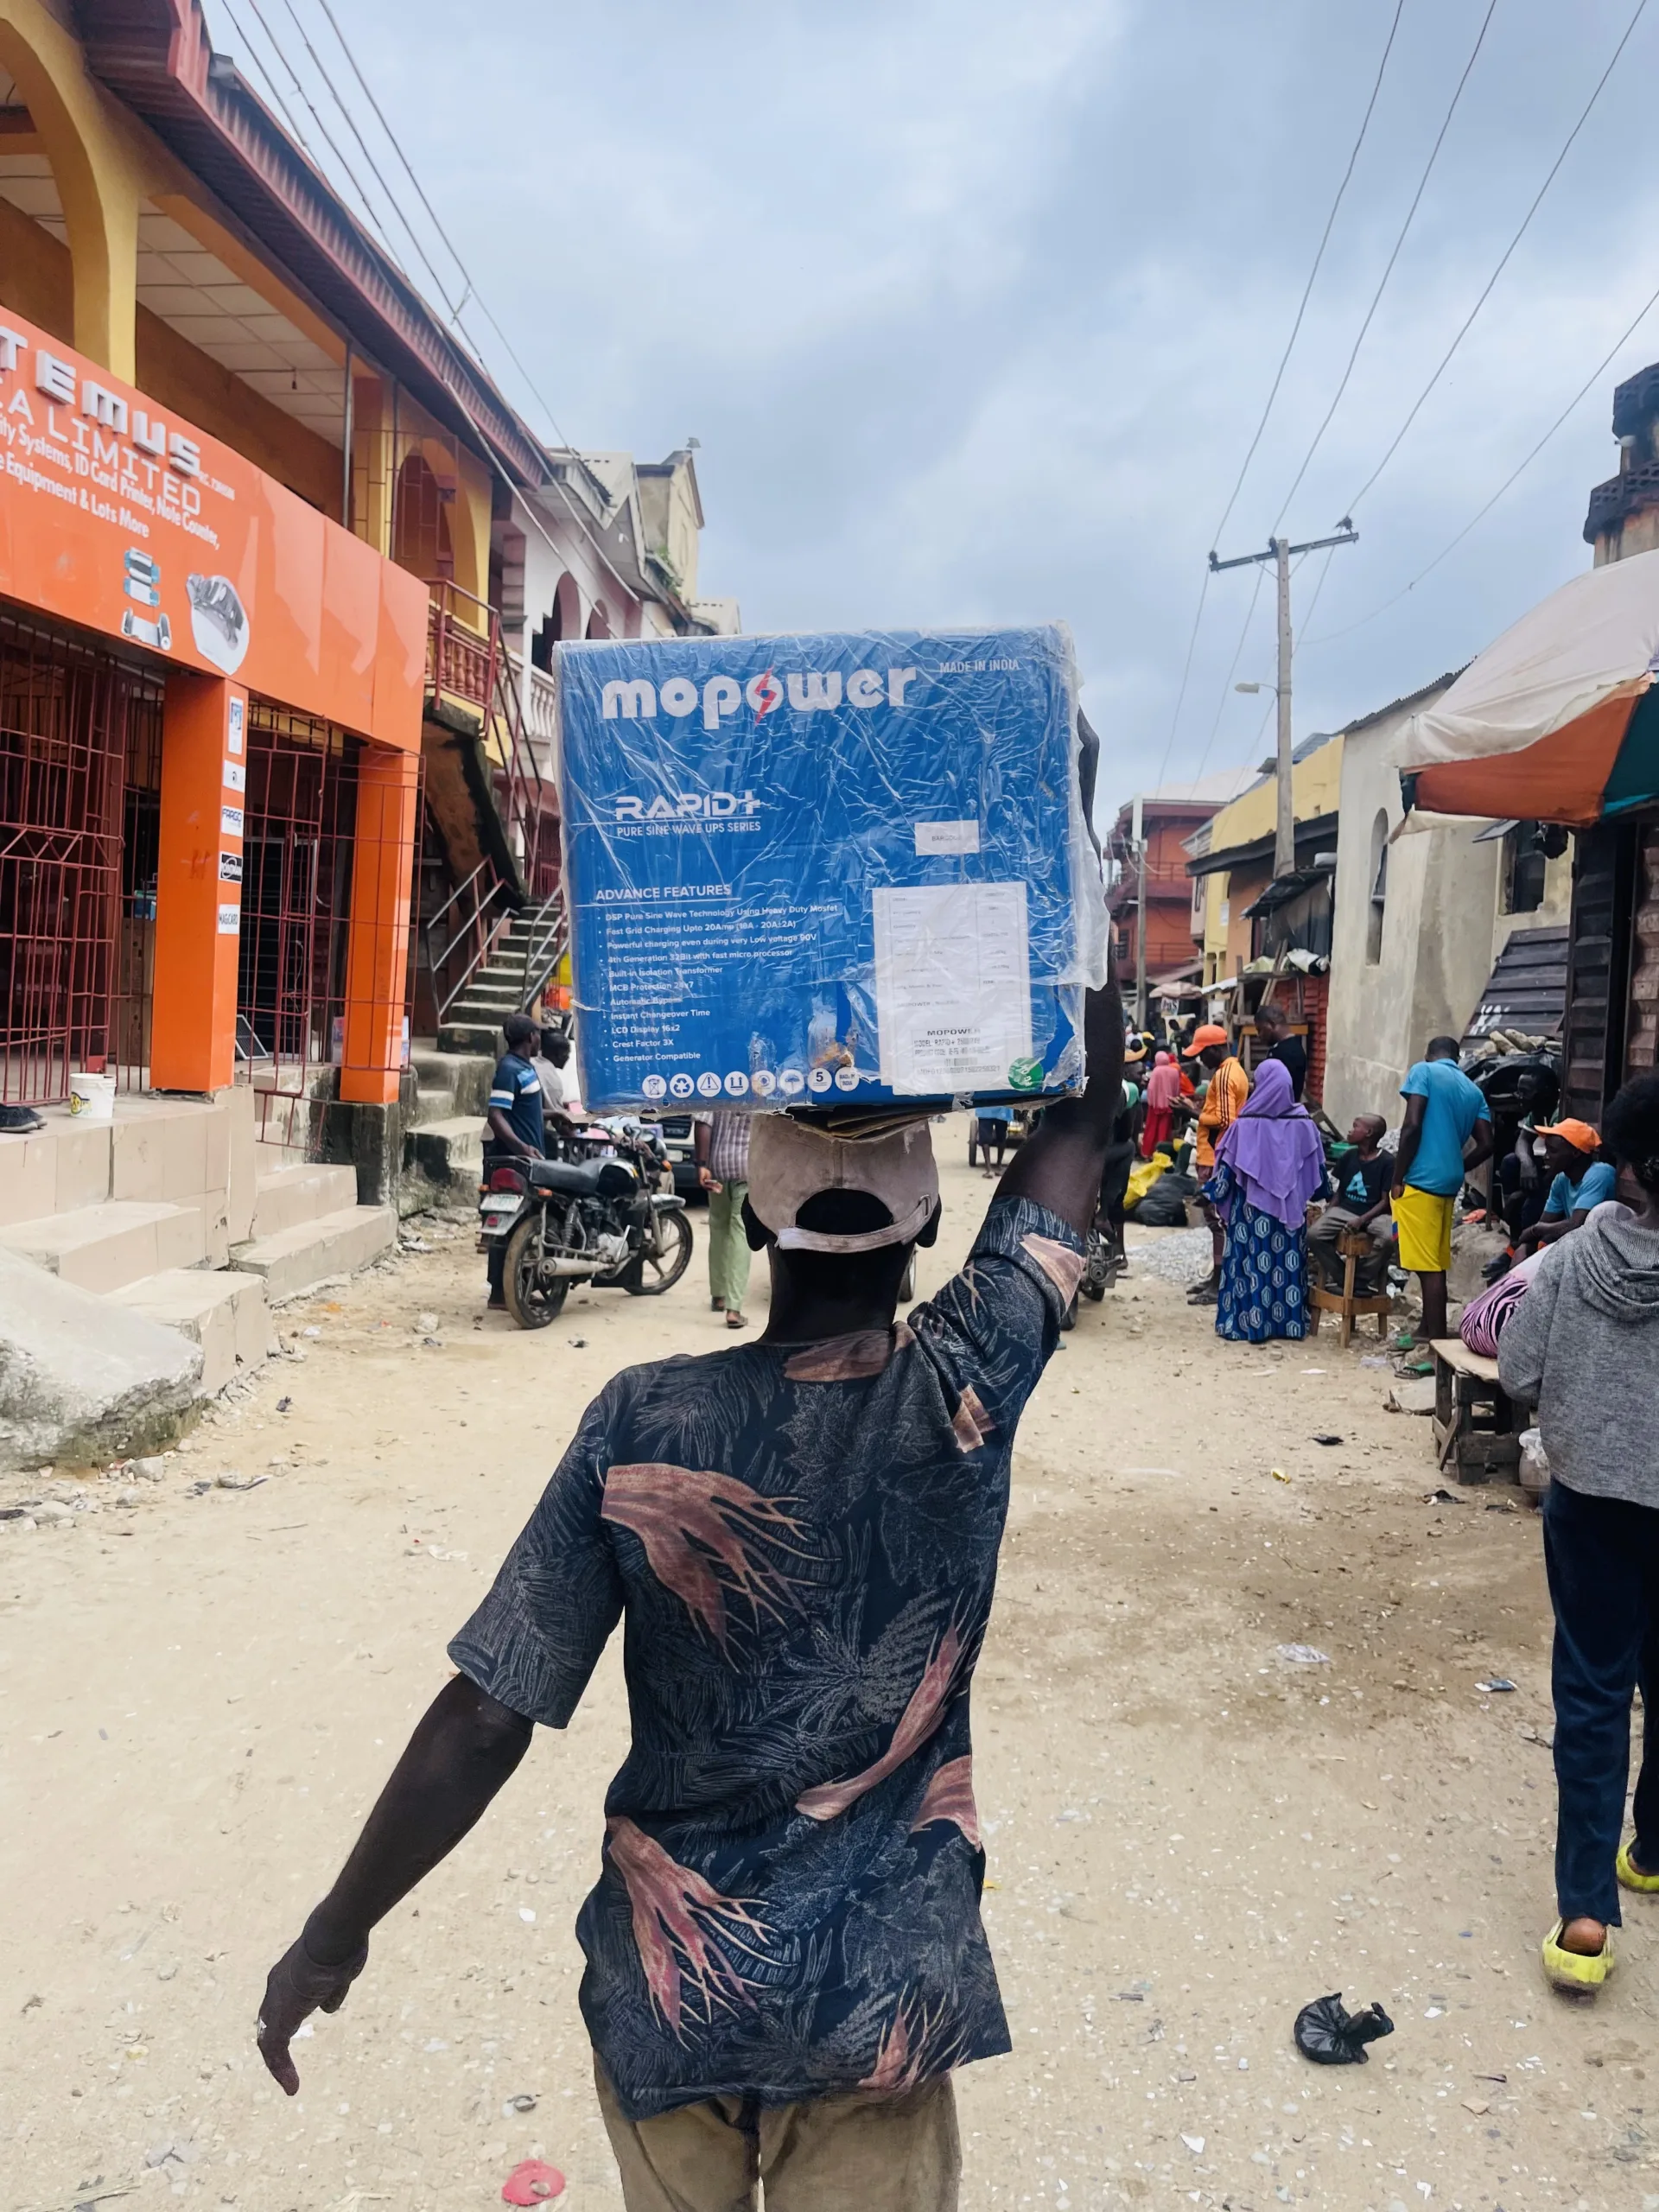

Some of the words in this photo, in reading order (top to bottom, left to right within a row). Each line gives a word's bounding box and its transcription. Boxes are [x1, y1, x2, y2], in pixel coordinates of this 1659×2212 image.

[18, 423, 73, 474] Systems,
[74, 453, 89, 476] ID
[90, 461, 118, 493] Card
[48, 405, 200, 516] LIMITED
[6, 451, 77, 505] Equipment
[79, 488, 90, 511] &
[91, 493, 118, 524] Lots
[119, 506, 149, 538] More
[940, 661, 972, 673] MADE
[975, 660, 985, 671] IN
[989, 658, 1020, 671] INDIA
[603, 665, 917, 729] mopower
[617, 826, 643, 837] PURE
[645, 825, 669, 836] SINE
[672, 823, 702, 835] WAVE
[705, 823, 725, 833] UPS
[727, 822, 761, 832] SERIES
[596, 887, 660, 900] ADVANCE
[664, 885, 732, 898] FEATURES
[689, 910, 734, 919] Technology
[645, 925, 681, 935] Charging
[683, 925, 702, 933] Upto
[645, 940, 679, 949] charging
[623, 954, 667, 963] Generation
[753, 950, 792, 958] processor
[655, 1052, 701, 1061] Compatible
[816, 1071, 823, 1082] 5
